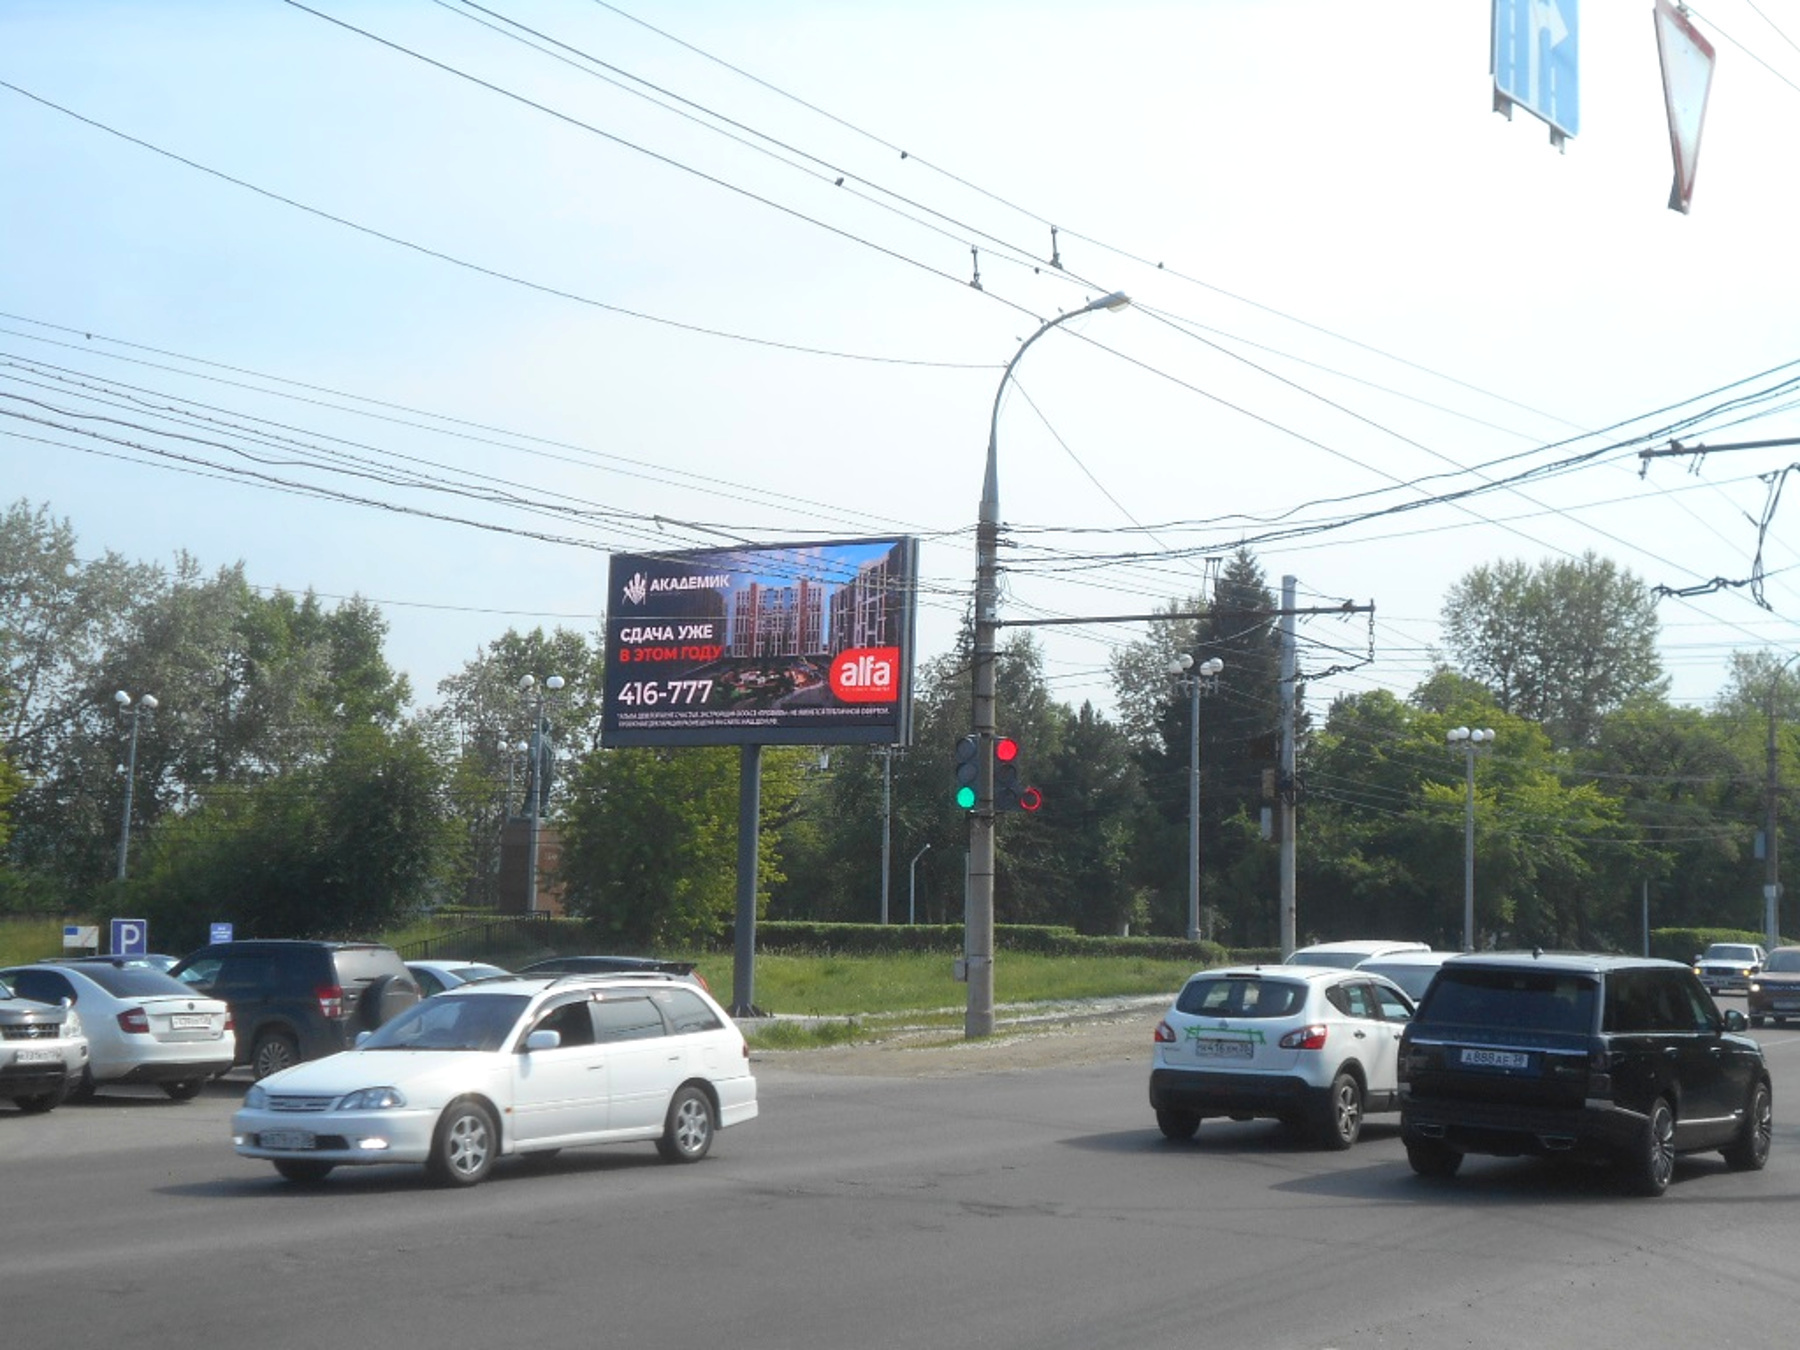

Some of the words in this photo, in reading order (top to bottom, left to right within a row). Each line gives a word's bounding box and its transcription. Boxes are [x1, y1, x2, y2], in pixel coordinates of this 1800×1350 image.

[650, 574, 730, 592] АКАДЕМИК
[620, 626, 674, 644] СДАЧА
[678, 624, 713, 640] УЖЕ
[619, 648, 630, 662] В
[634, 646, 678, 661] ЭТОМ
[681, 644, 722, 661] ГОДУ
[840, 655, 890, 686] alfa
[618, 680, 713, 705] 416-777
[121, 924, 140, 955] P
